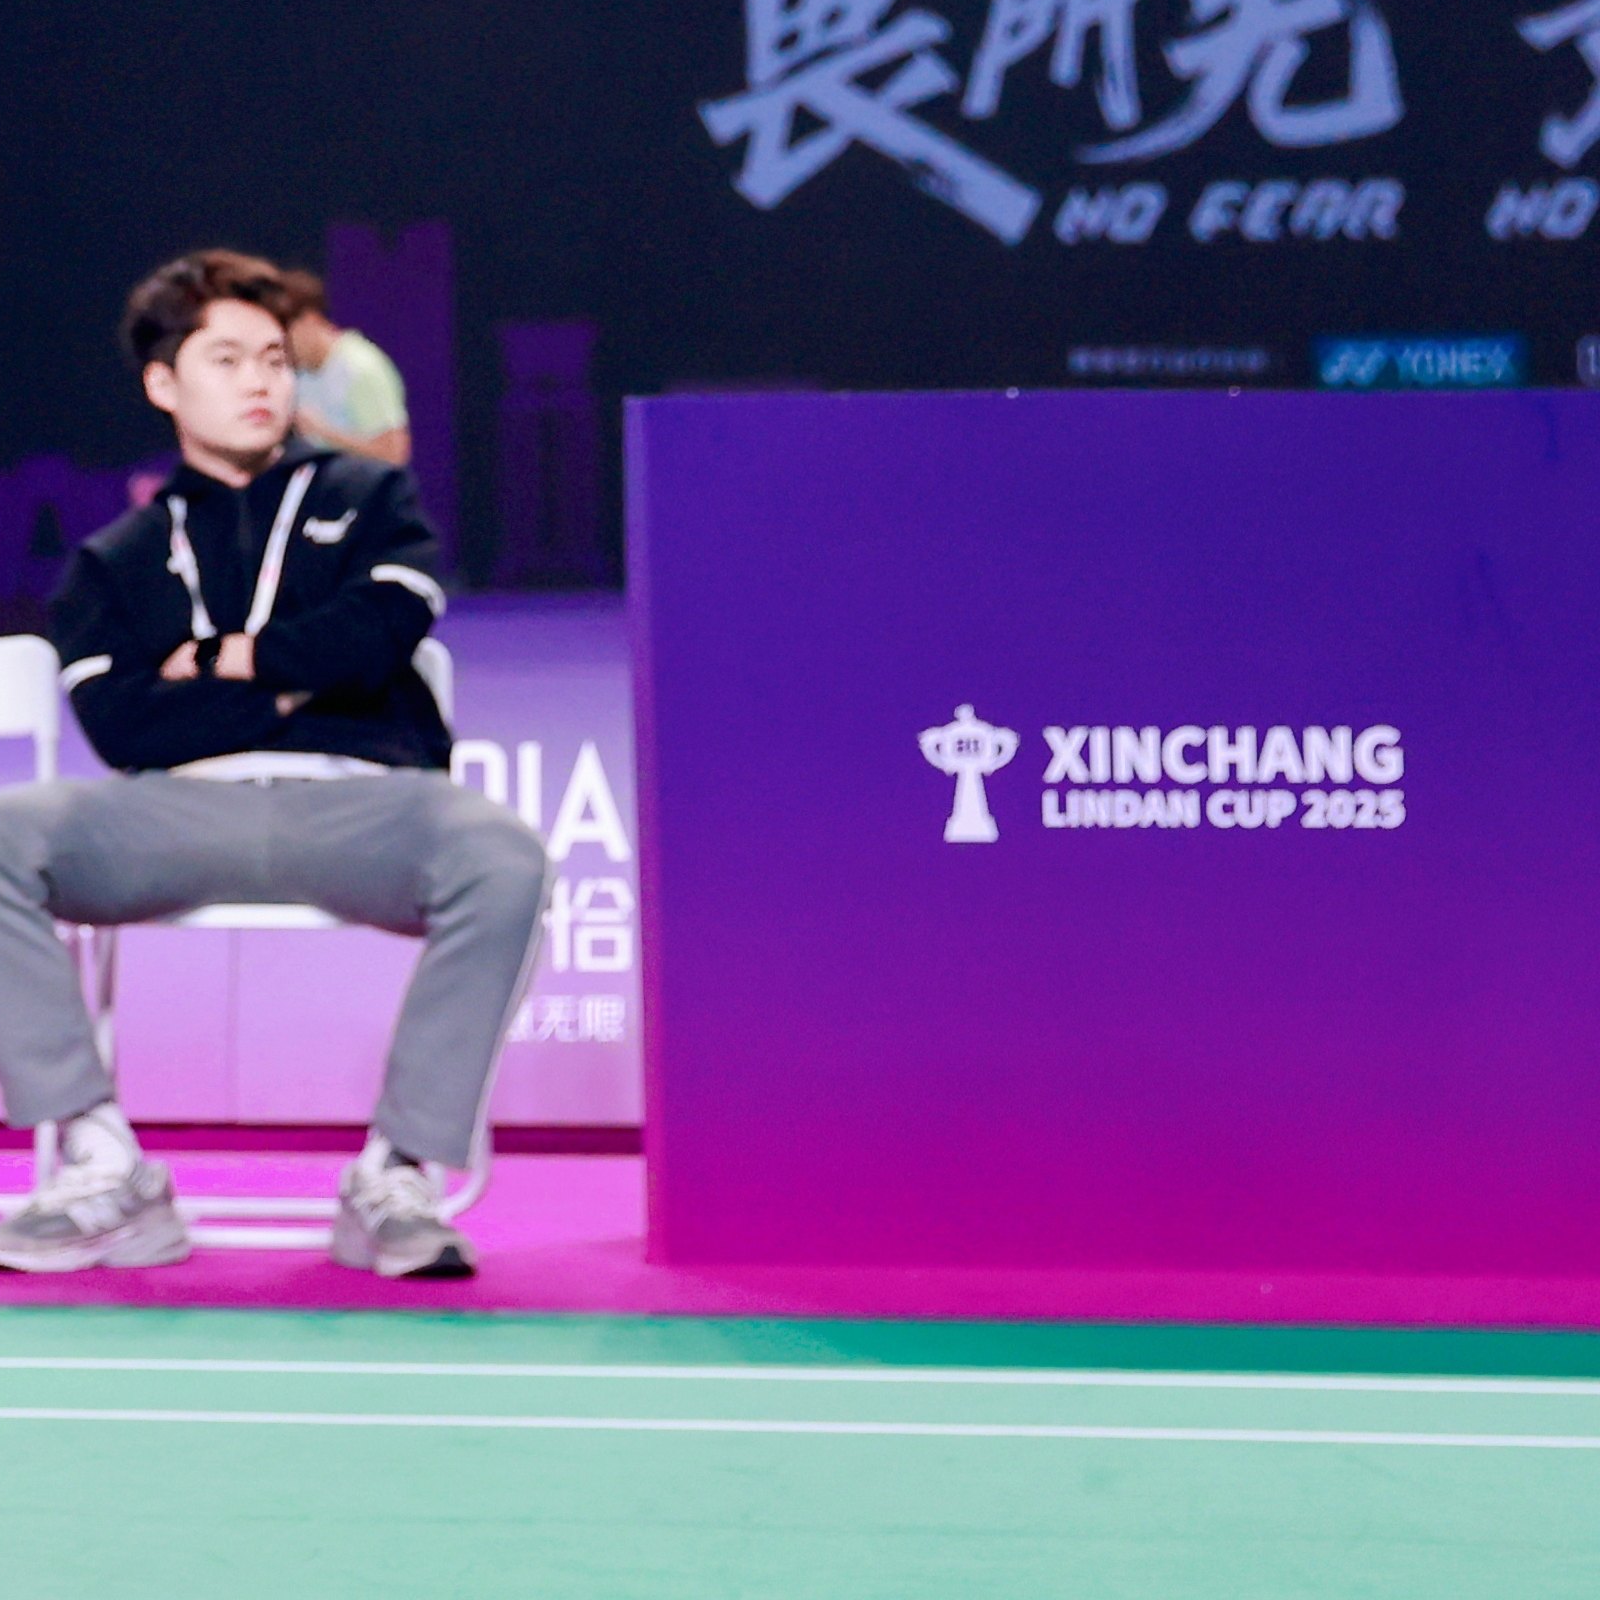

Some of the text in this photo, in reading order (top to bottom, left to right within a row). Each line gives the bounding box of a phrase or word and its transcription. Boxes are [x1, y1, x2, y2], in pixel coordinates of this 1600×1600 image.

[1053, 177, 1406, 246] NO FEAR
[1484, 176, 1599, 241] NO
[1041, 725, 1405, 784] XINCHANG
[1041, 789, 1406, 829] LINDAN CUP 2025
